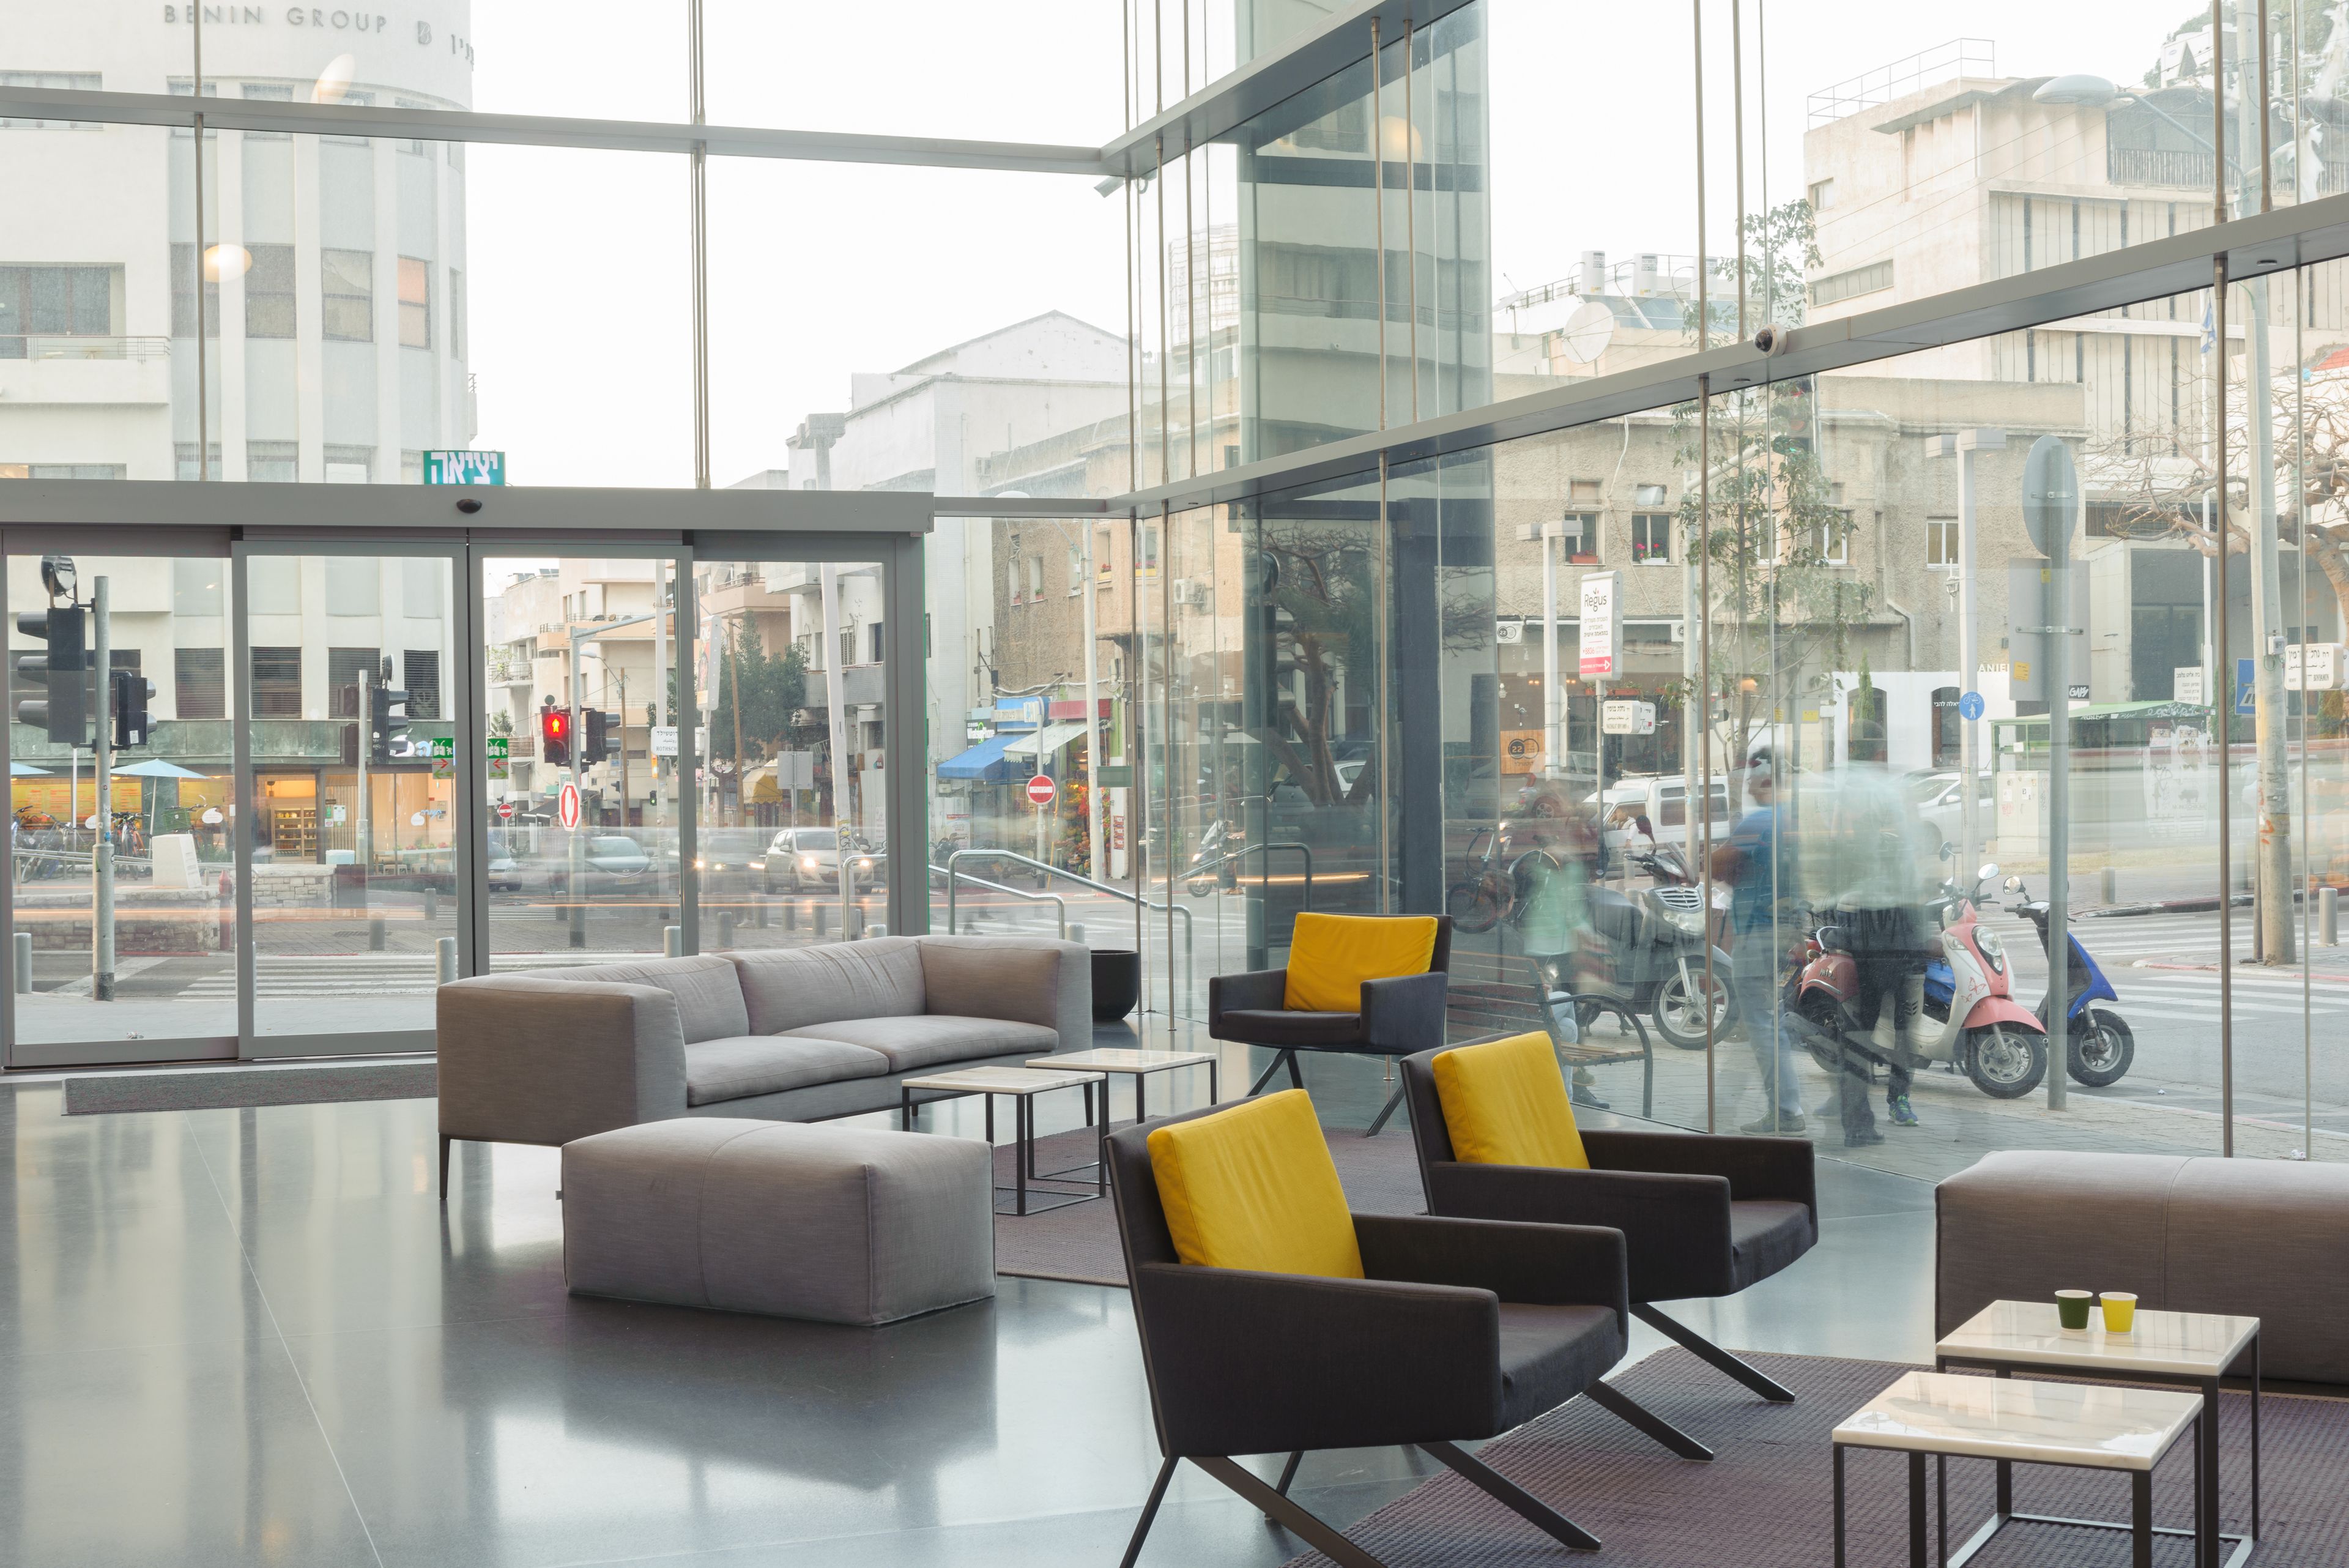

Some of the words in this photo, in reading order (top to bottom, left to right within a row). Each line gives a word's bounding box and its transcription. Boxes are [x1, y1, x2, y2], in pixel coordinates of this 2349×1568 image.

[165, 5, 261, 24] BENIN
[287, 7, 387, 33] GROUP
[431, 452, 498, 484] יציאה
[1584, 593, 1607, 612] Regus
[1978, 663, 2009, 672] ANIE
